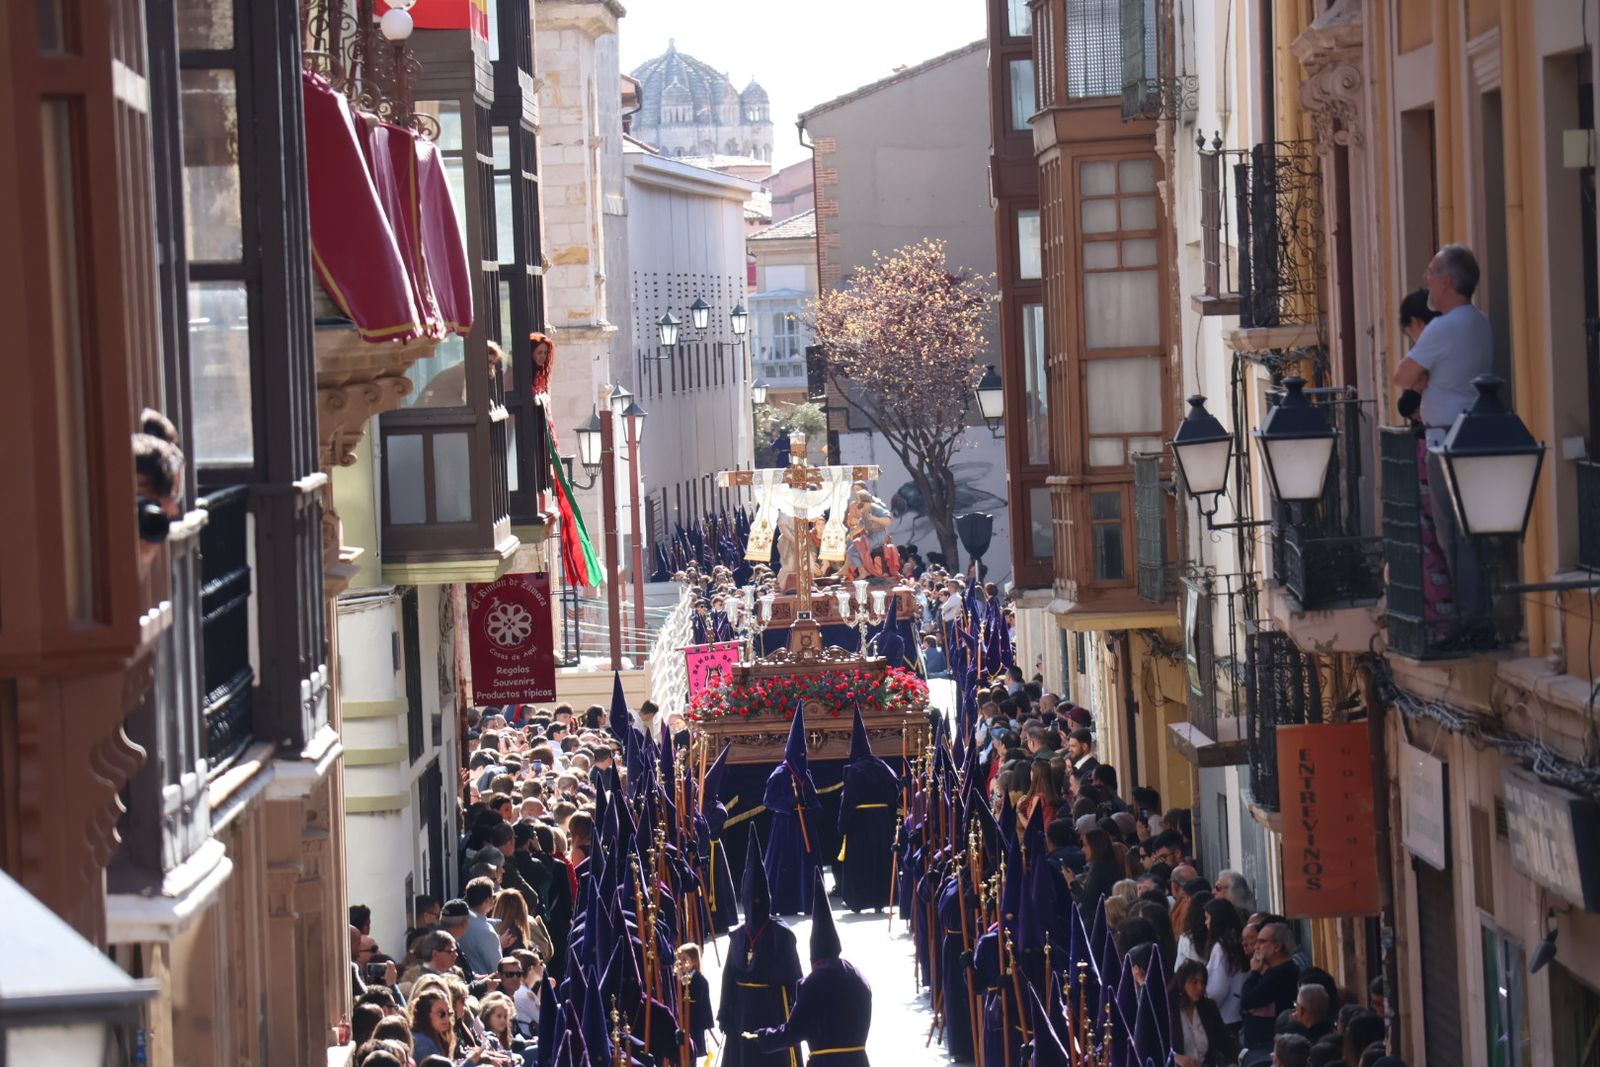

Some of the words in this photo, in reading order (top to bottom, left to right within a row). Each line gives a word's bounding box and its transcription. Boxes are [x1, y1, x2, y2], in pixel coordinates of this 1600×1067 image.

[520, 580, 547, 607] Zamora
[496, 665, 531, 677] Regalos
[692, 654, 715, 675] BANDA
[492, 677, 536, 688] Souvenirs
[476, 691, 521, 701] Productos
[1298, 748, 1323, 891] ENTREVINOS
